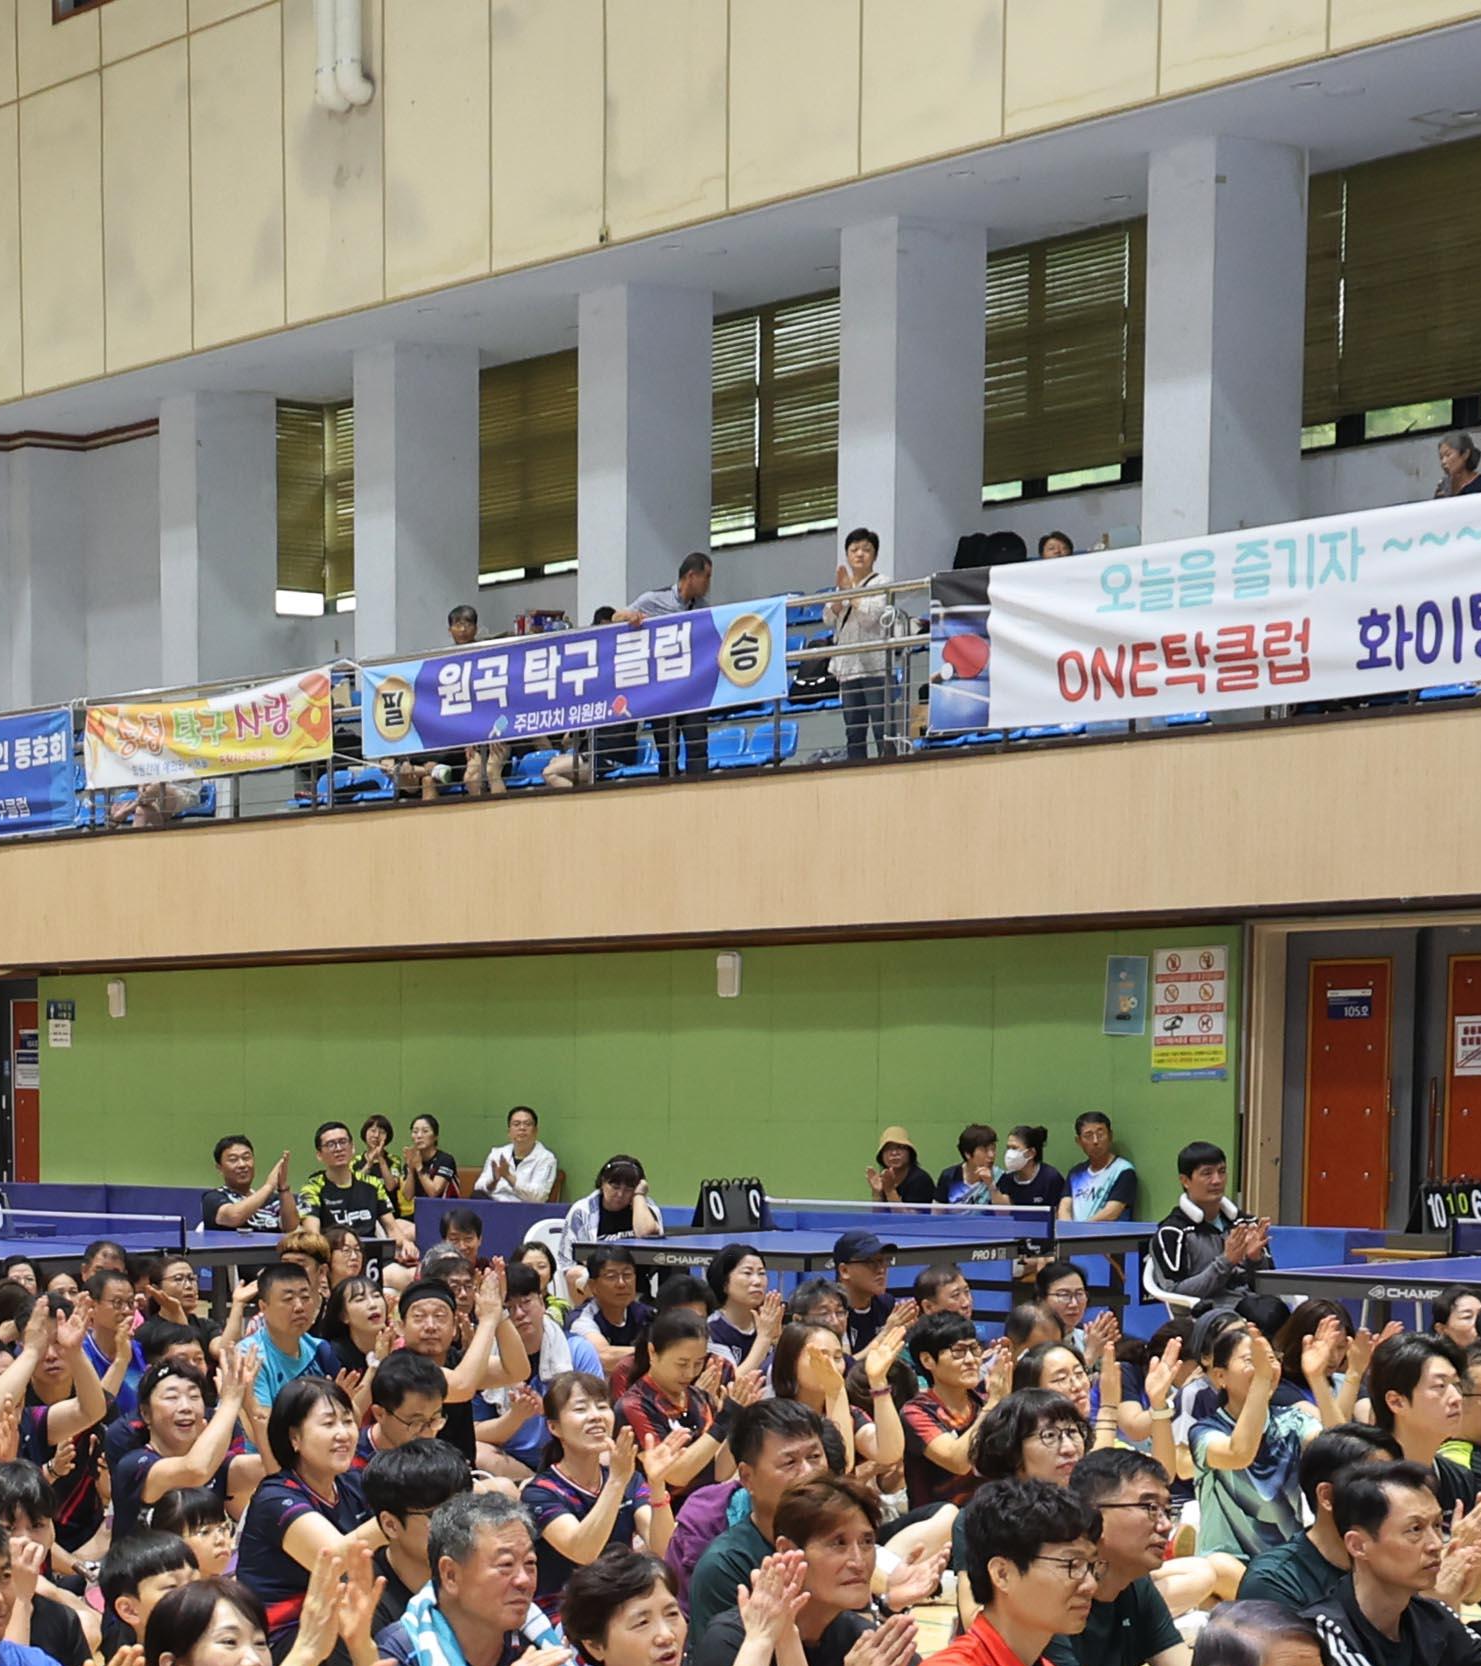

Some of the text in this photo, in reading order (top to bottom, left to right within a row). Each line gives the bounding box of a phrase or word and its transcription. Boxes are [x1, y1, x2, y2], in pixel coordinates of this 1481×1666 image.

[1097, 557, 1218, 617] 오늘을
[1232, 526, 1366, 602] 즐기자
[437, 619, 693, 717] 원곡 탁구 클럽
[1056, 617, 1312, 704] ONE탁클럽
[172, 707, 230, 748] 탁구
[233, 692, 294, 742] 사랑
[383, 690, 405, 726] 필
[513, 708, 565, 733] 주민자치
[13, 731, 67, 769] 동호회
